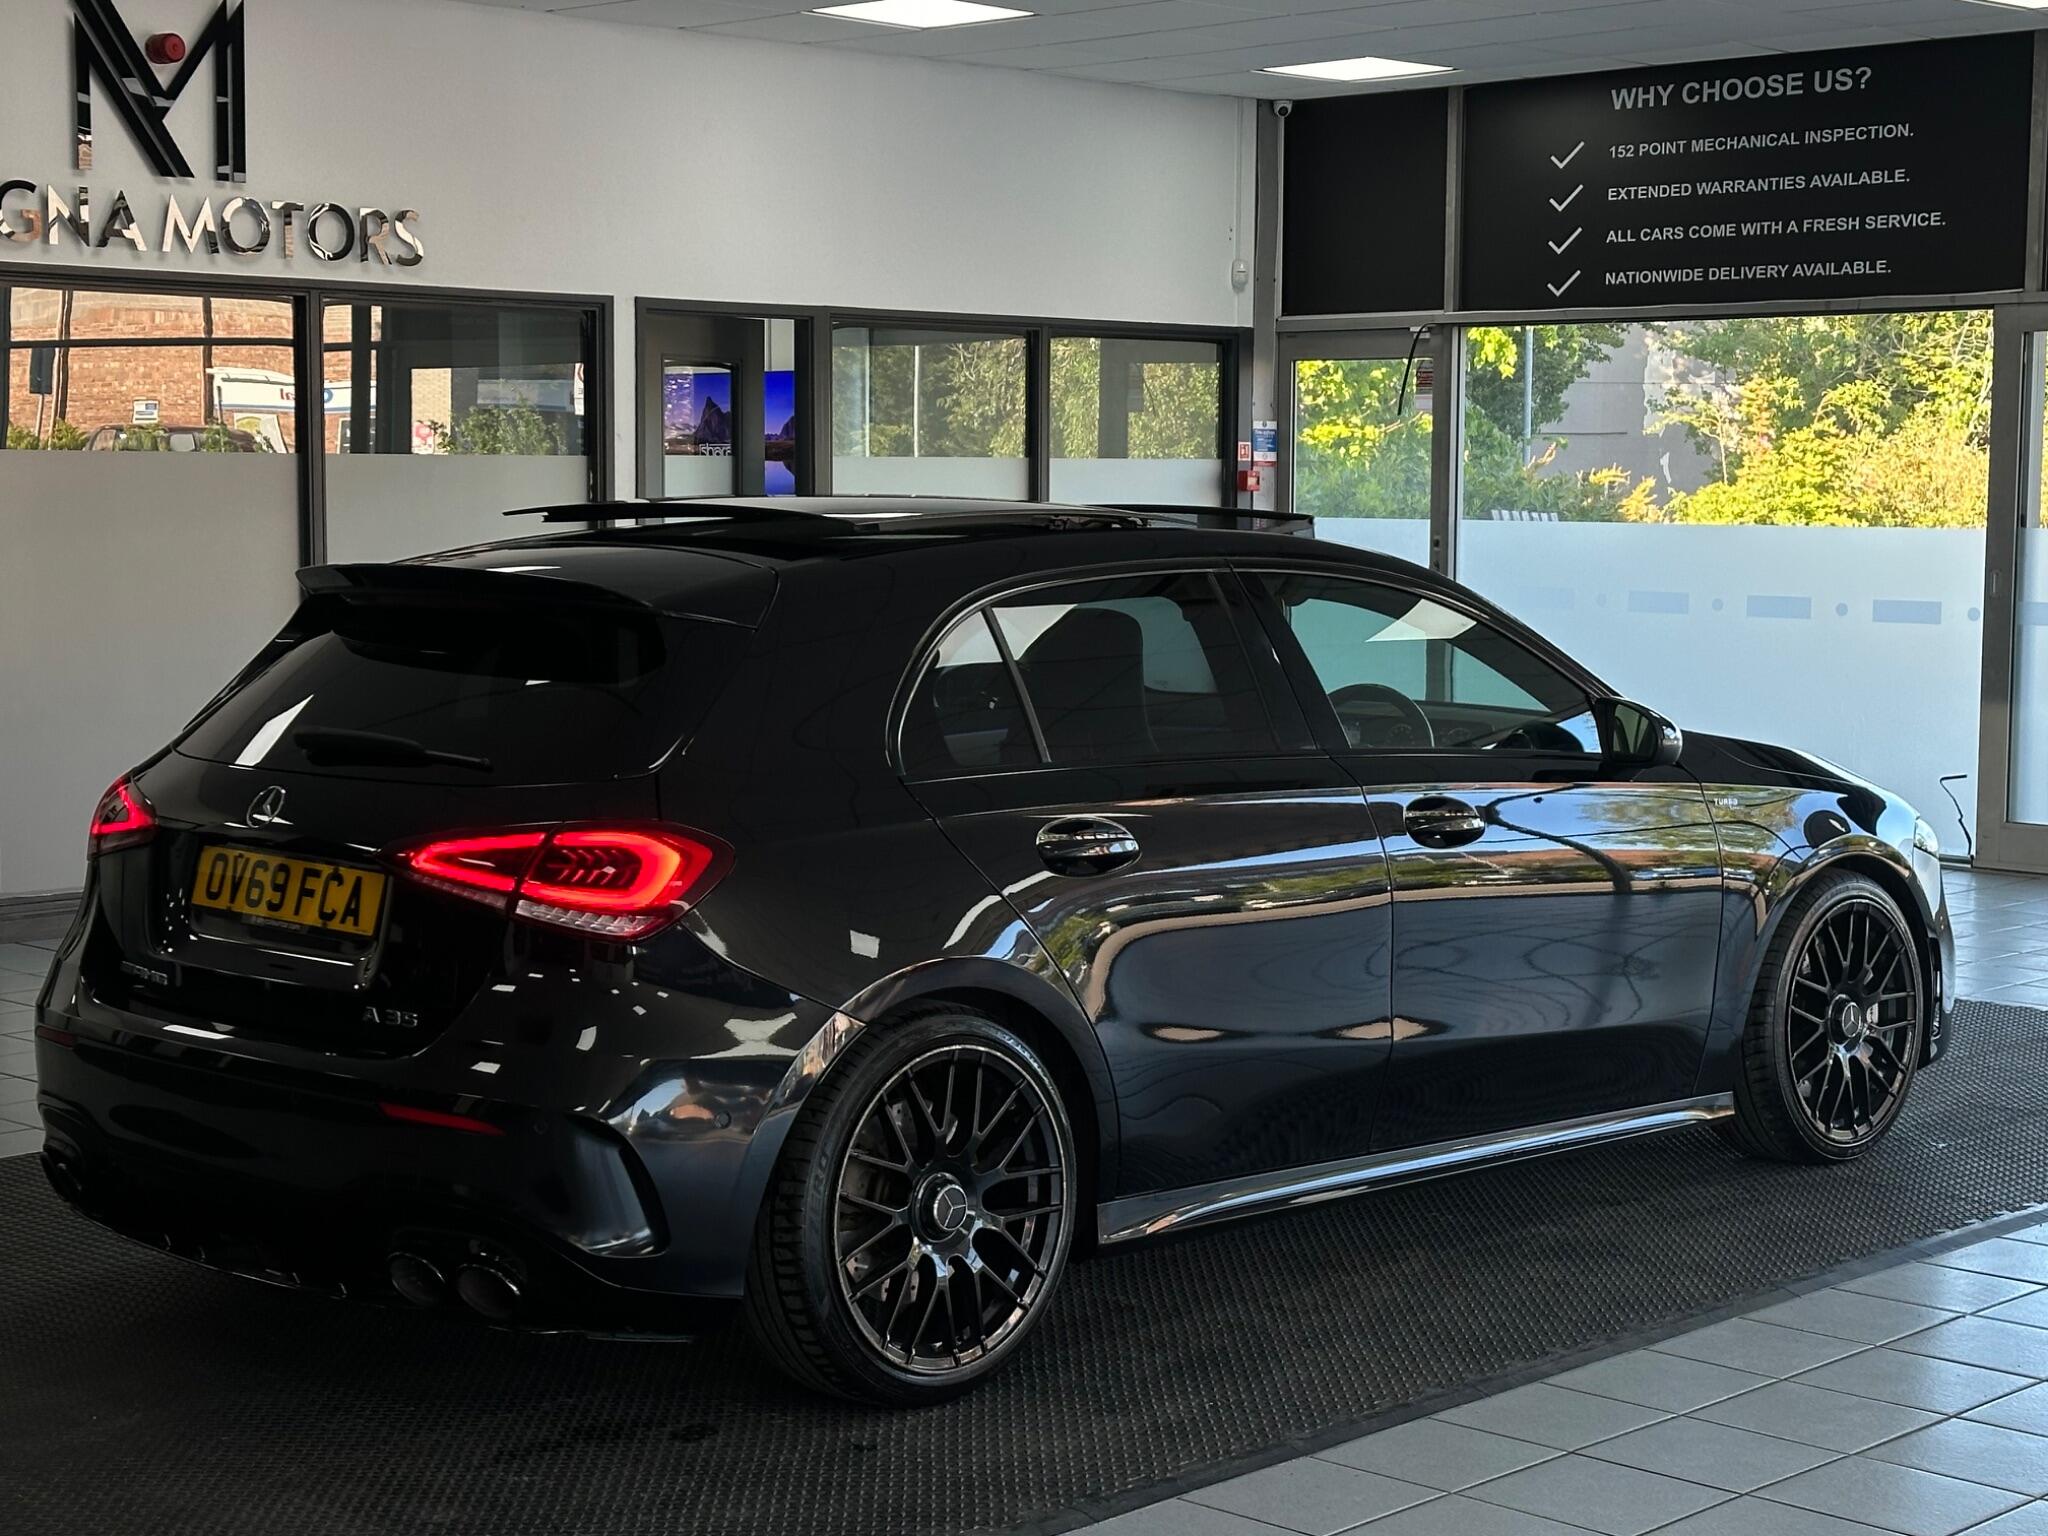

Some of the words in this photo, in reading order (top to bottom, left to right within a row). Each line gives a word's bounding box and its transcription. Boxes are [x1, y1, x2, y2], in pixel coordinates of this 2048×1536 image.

[1611, 83, 1675, 111] WHY
[1681, 72, 1804, 104] CHOOSE
[1813, 66, 1872, 93] US?
[1608, 144, 1635, 159] 152
[1638, 139, 1687, 156] POINT
[1691, 131, 1800, 152] MECHANICAL
[1804, 123, 1914, 144] INSPECTION.
[1607, 183, 1692, 201] EXTENDED
[1696, 175, 1806, 195] WARRANTIES
[1809, 168, 1910, 188] AVAILABLE.
[161, 193, 425, 267] MOTORS
[1606, 229, 1636, 243] ALL
[1640, 226, 1684, 242] CARS
[1688, 223, 1737, 239] COME
[1741, 220, 1783, 236] WITH
[1786, 220, 1799, 234] A
[1803, 216, 1860, 232] FRESH
[1865, 211, 1947, 229] SERVICE.
[1605, 268, 1704, 285] NATIONWIDE
[1708, 264, 1789, 281] DELIVERY
[1792, 259, 1892, 278] AVAILABLE.
[205, 852, 291, 913] OV69
[293, 866, 364, 927] FCA
